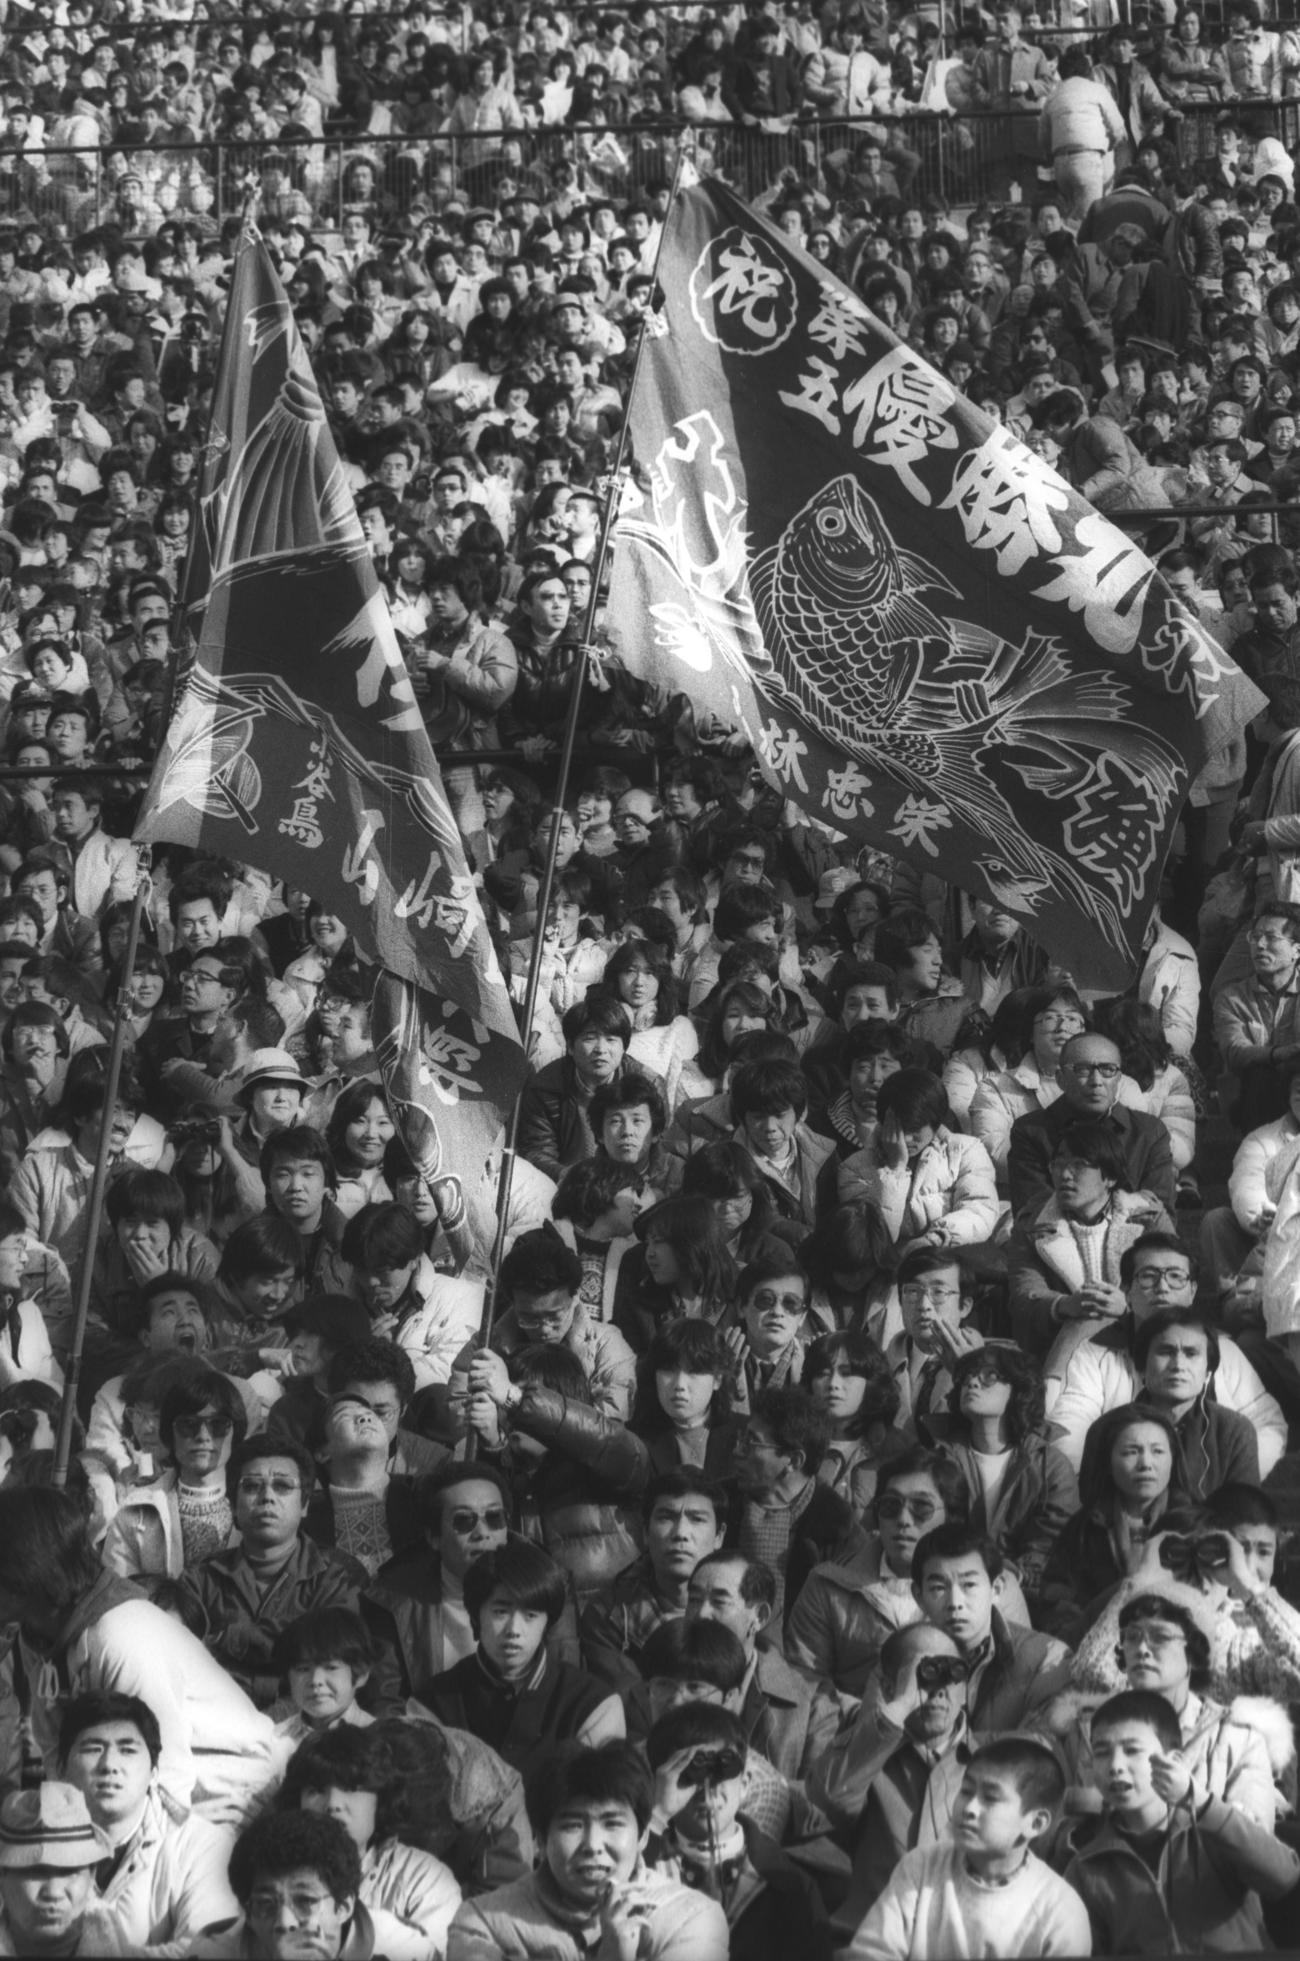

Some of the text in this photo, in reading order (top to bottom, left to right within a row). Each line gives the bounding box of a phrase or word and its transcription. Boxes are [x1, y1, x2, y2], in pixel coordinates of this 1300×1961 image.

[701, 234, 784, 338] 祝
[731, 685, 953, 858] 林忠栄
